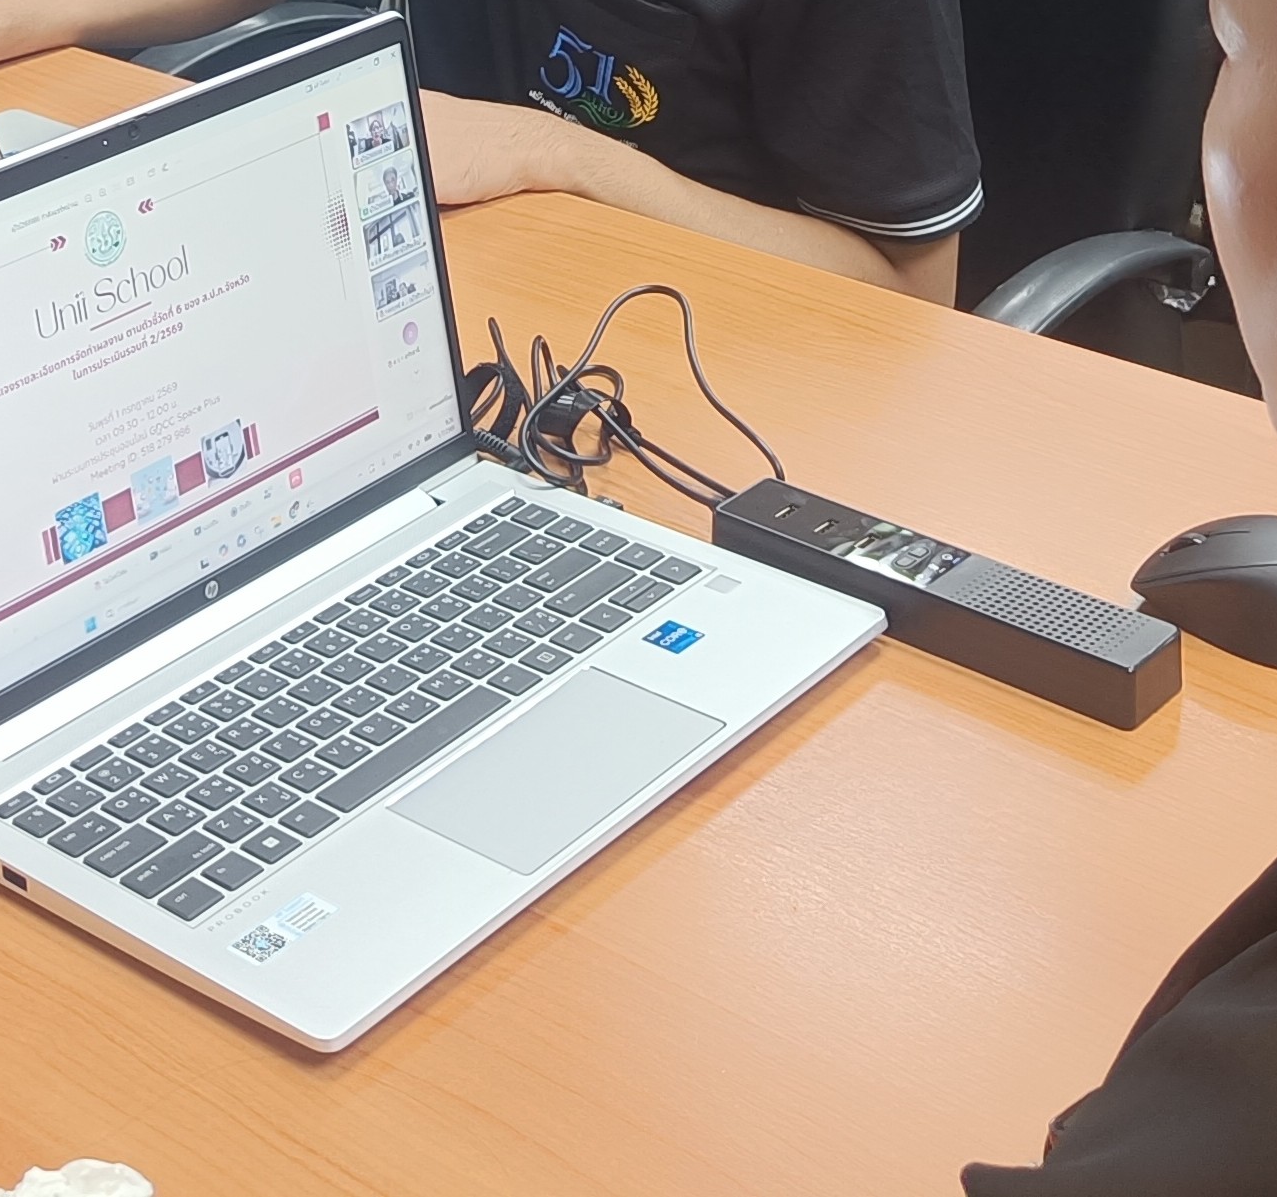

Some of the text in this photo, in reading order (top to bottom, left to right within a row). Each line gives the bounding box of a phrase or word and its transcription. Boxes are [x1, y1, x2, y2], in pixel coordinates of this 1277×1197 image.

[540, 25, 615, 104] 51
[93, 244, 189, 313] School
[175, 304, 183, 315] 6
[184, 296, 200, 312] ของ
[150, 321, 184, 345] 2/2569
[156, 381, 179, 400] 2569
[177, 405, 202, 423] Space
[204, 395, 222, 408] Plus
[90, 458, 126, 482] Meeting
[207, 889, 269, 932] PROBOOK
